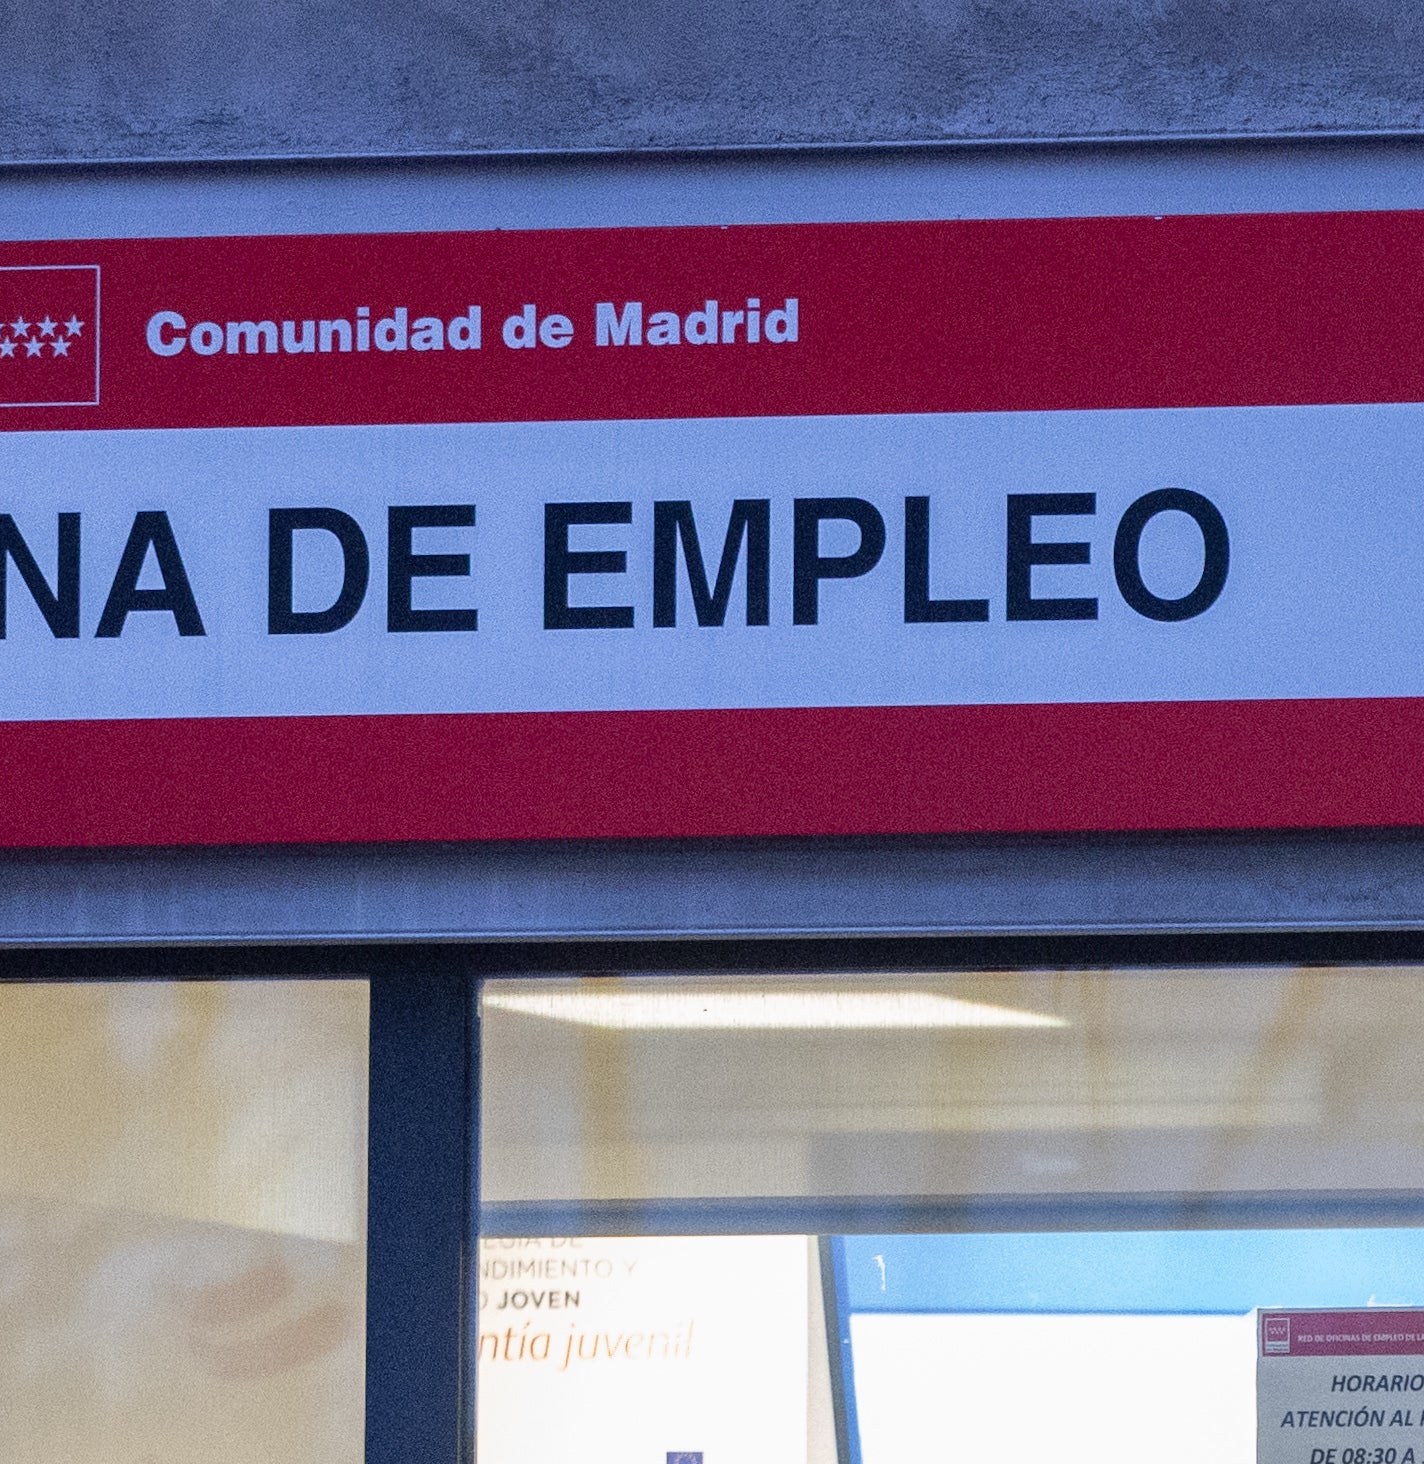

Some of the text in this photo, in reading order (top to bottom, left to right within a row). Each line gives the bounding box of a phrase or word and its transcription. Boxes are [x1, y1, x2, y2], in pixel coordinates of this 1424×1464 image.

[145, 298, 800, 357] Comunidad de Madrid
[267, 504, 478, 635] DE
[542, 487, 1234, 632] EMPLEO
[497, 1291, 581, 1310] JOVEN
[559, 1318, 695, 1371] juvenil
[1331, 1375, 1424, 1393] HORARIO
[1280, 1405, 1385, 1428] ATENCIÓN
[1389, 1409, 1414, 1427] AL
[1401, 1447, 1416, 1464] A
